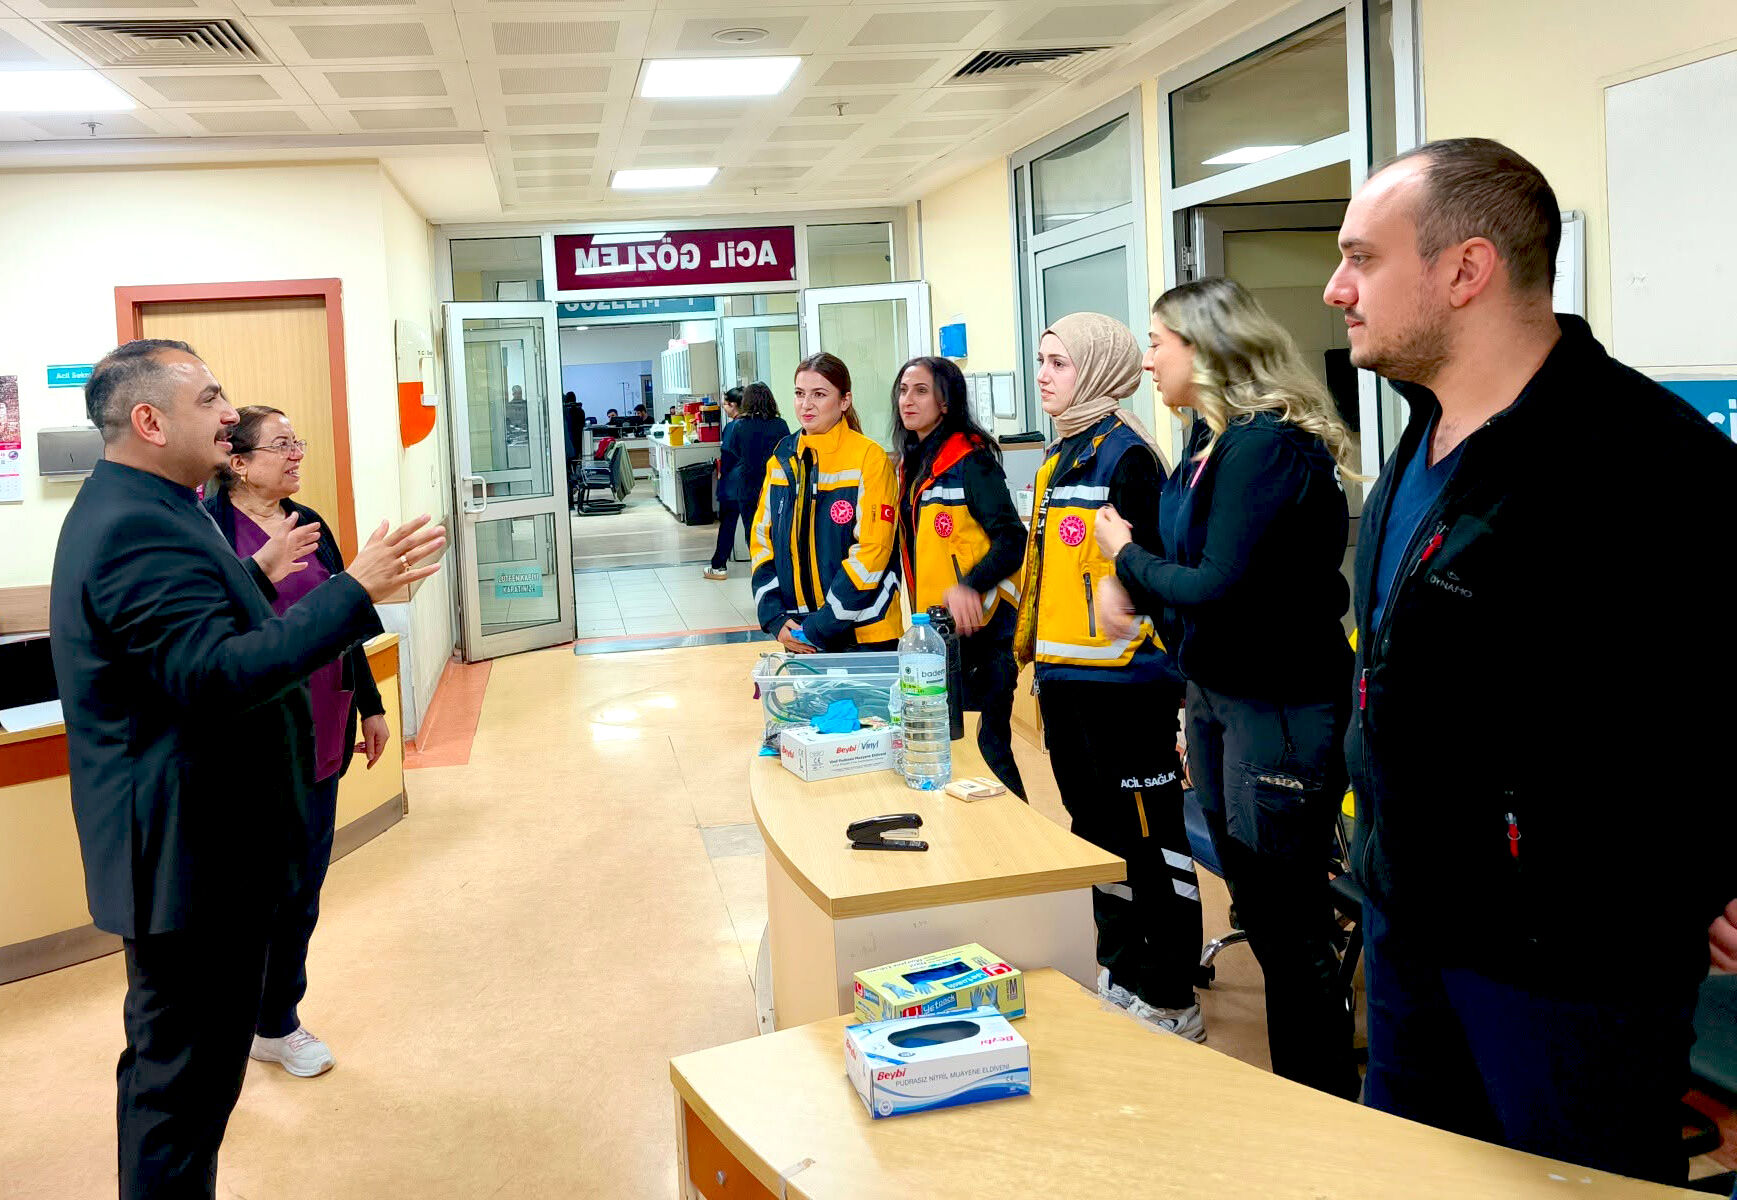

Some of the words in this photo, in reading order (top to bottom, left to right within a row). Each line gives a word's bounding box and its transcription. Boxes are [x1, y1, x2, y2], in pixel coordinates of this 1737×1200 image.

[1430, 575, 1473, 598] DYNAMO
[836, 744, 857, 754] Beybi
[861, 740, 879, 750] Vinyl
[1120, 776, 1143, 788] ACİL
[1144, 770, 1177, 788] SAĞLIK
[877, 1067, 907, 1081] Beybi
[895, 1076, 929, 1087] PUDRASIZ
[950, 1068, 980, 1078] MUAYENE
